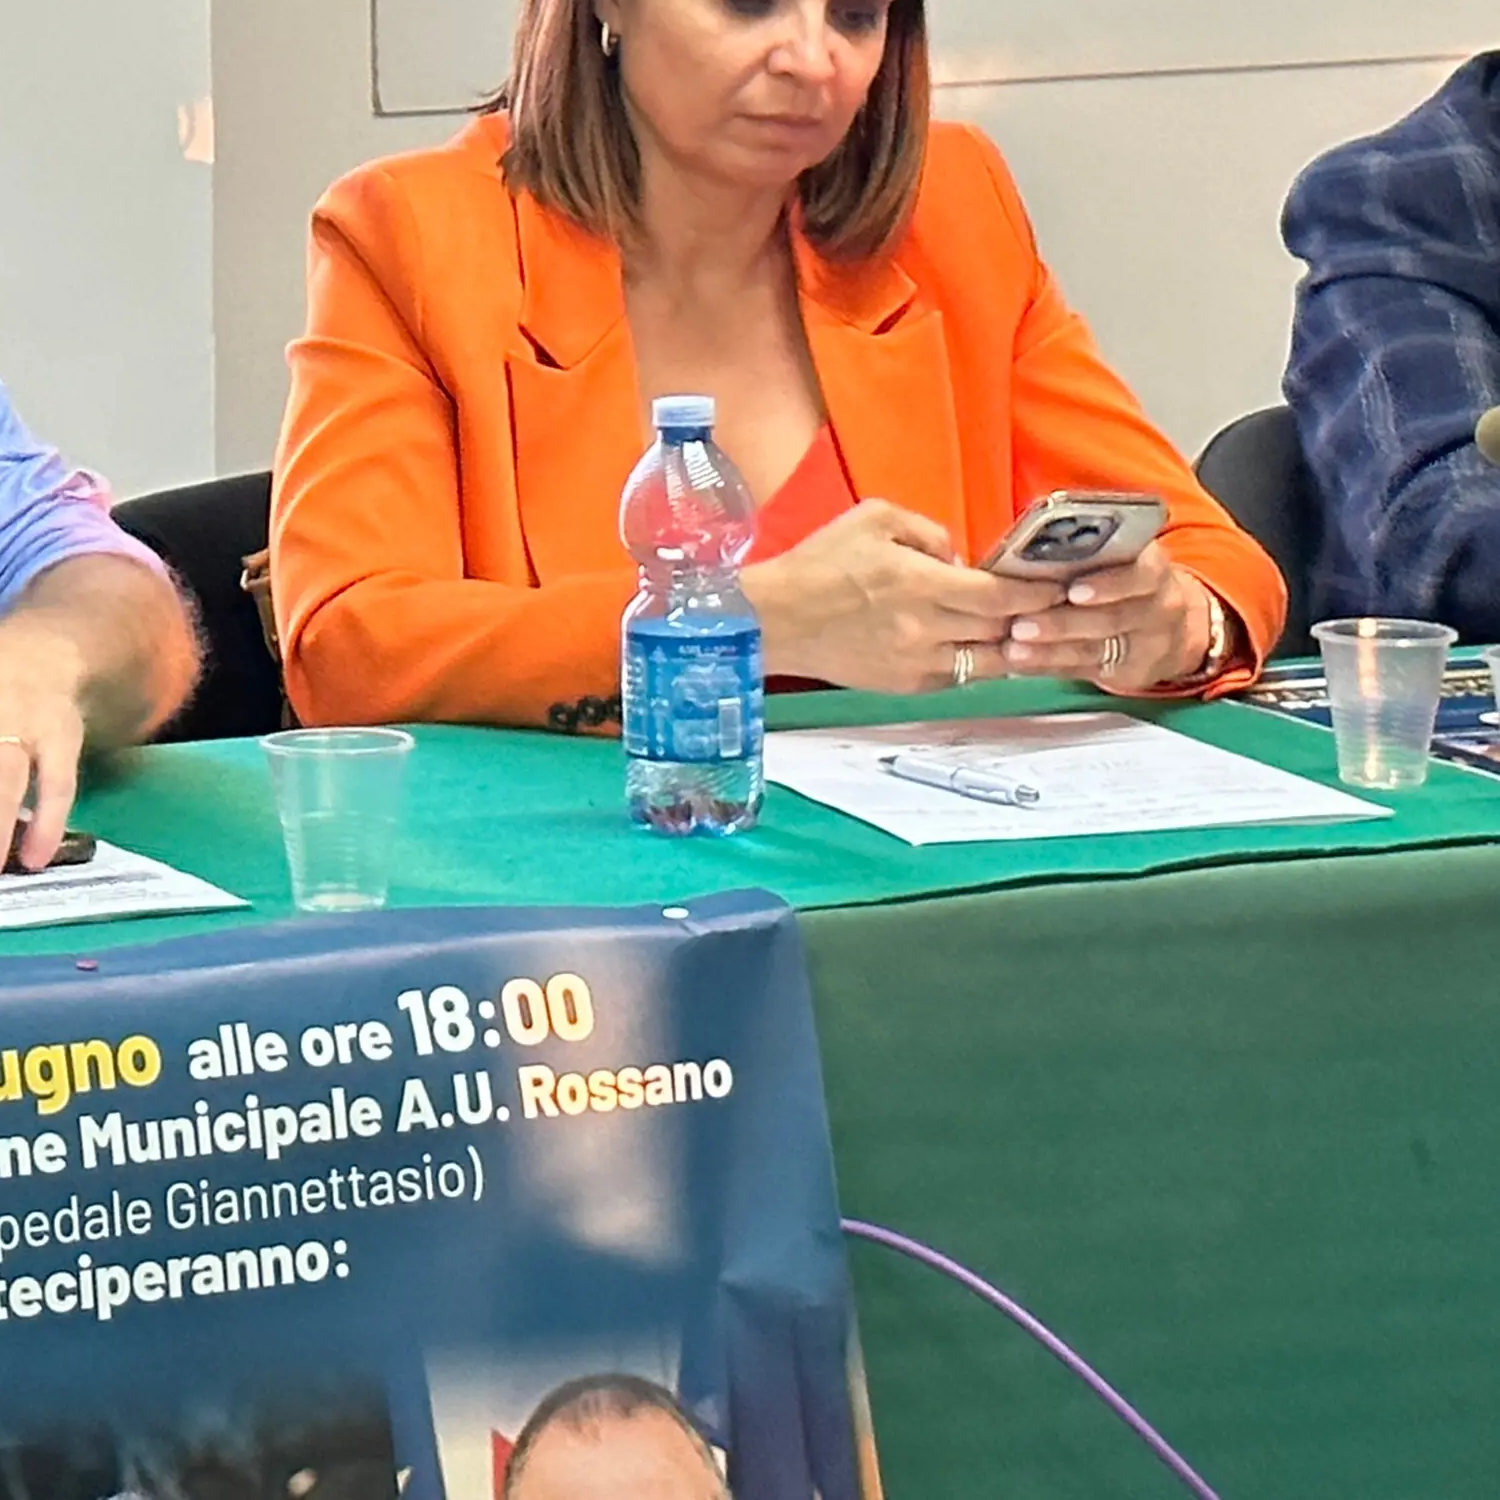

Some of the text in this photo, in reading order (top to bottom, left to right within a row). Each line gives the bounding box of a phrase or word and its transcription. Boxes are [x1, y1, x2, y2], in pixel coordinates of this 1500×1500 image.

[187, 1023, 288, 1080] alle
[300, 1016, 393, 1068] ore
[396, 972, 595, 1057] 18:00
[79, 1085, 383, 1170] Municipale
[396, 1070, 510, 1133] A.U.
[518, 1057, 733, 1120] Rossano
[165, 1145, 484, 1233] Giannettasio)
